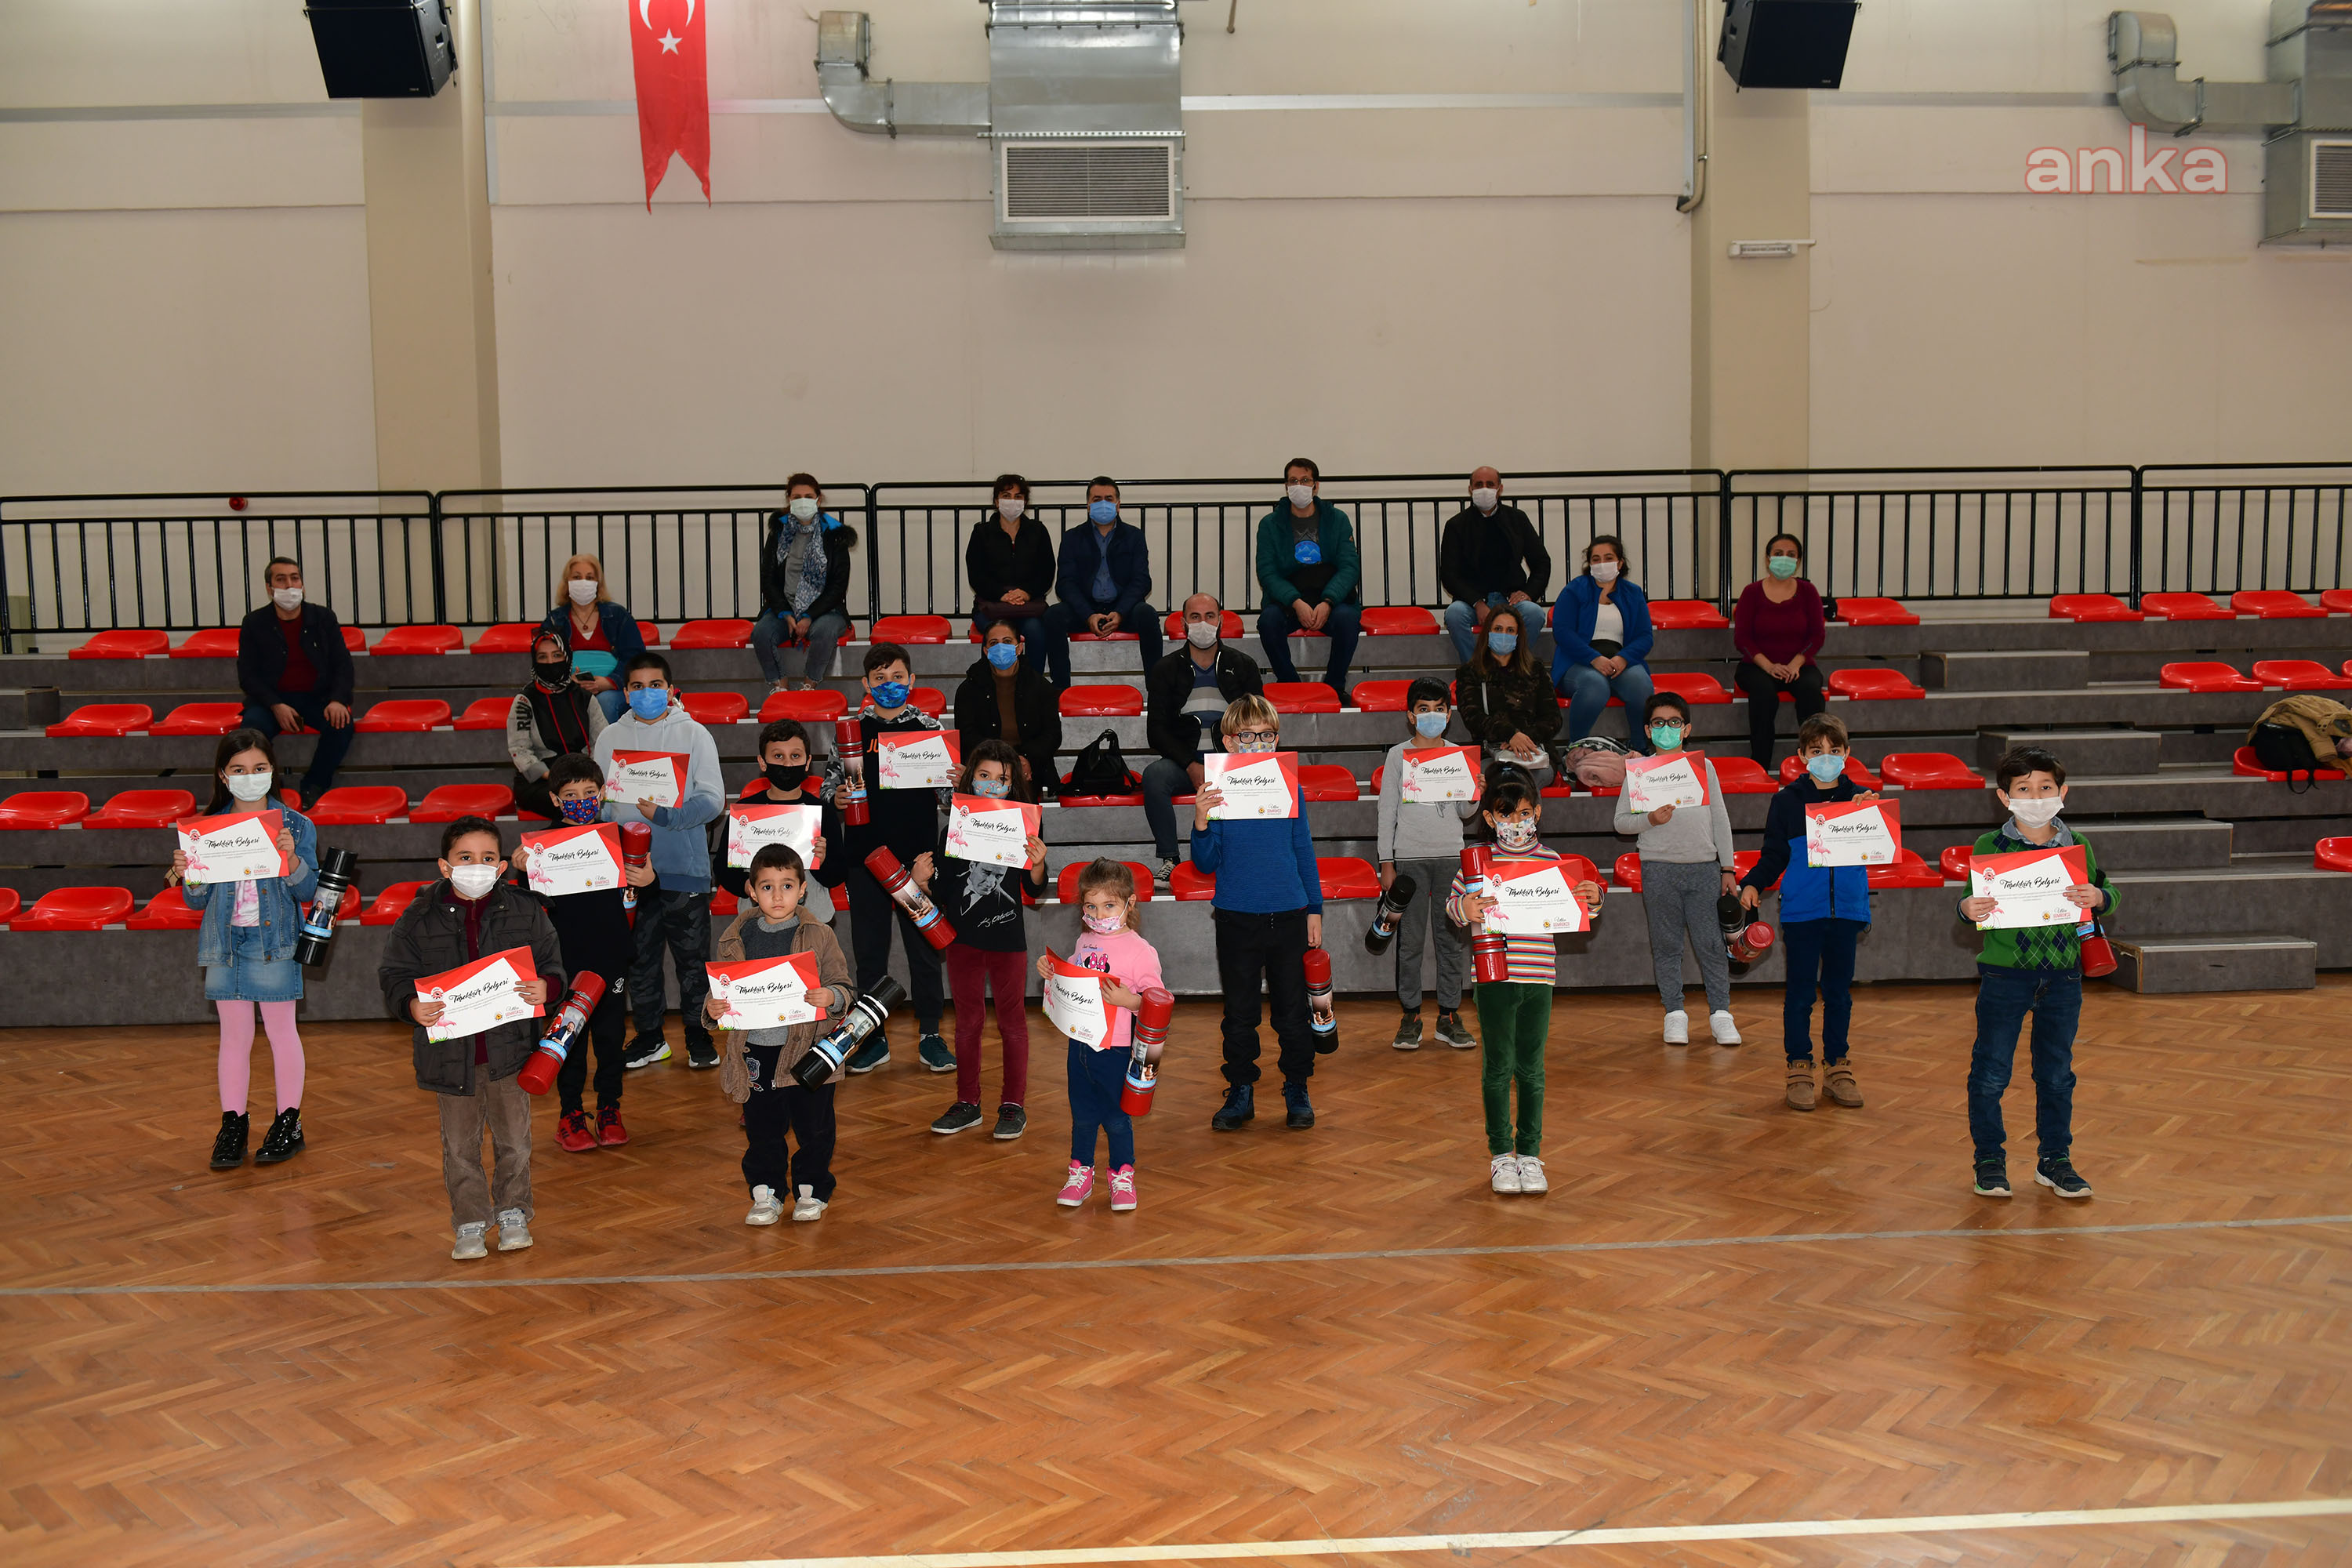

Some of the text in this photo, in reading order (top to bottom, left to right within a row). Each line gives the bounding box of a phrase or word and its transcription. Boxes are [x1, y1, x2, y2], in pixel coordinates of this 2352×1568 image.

[922, 751, 942, 760] Belgesi
[1227, 775, 1276, 786] Teşekkür Belgesi
[751, 826, 777, 836] Teşekkür
[971, 818, 1017, 833] Teşekkür Belgesi
[1828, 823, 1878, 833] Teşekkür Belgesi
[205, 837, 260, 848] Teşekkür Belgesi
[548, 849, 599, 861] Teşekkür Belgesi
[1999, 876, 2060, 890] Teşekkür Belgesi
[1505, 886, 1559, 897] Teşekkür Belgesi
[448, 989, 481, 1003] Teşekkür
[482, 978, 509, 993] Belgesi
[735, 982, 793, 994] Teşekkür Belgesi
[1071, 991, 1094, 1004] Belgesi
